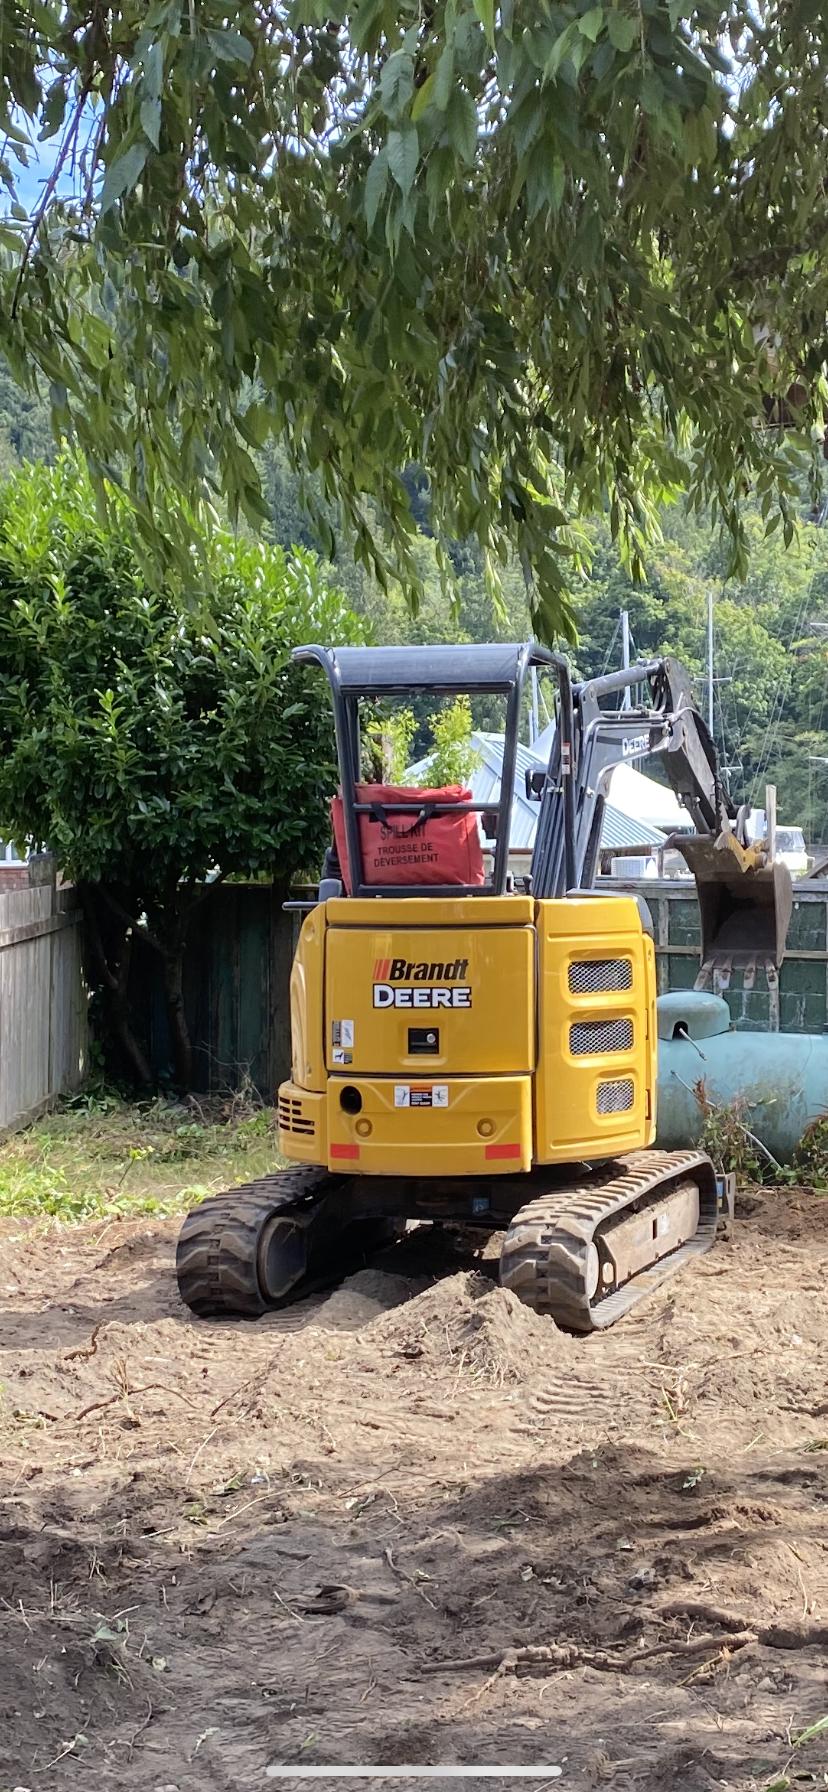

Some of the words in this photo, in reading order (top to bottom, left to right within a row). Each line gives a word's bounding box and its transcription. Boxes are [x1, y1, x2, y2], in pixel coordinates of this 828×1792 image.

[622, 733, 650, 757] DEERE
[380, 824, 408, 840] SPILL
[377, 844, 418, 855] TROUSSE
[421, 842, 433, 851] DE
[374, 853, 439, 867] DÉVERSEMENT
[389, 958, 469, 980] Brandt
[373, 983, 472, 1009] DEERE
